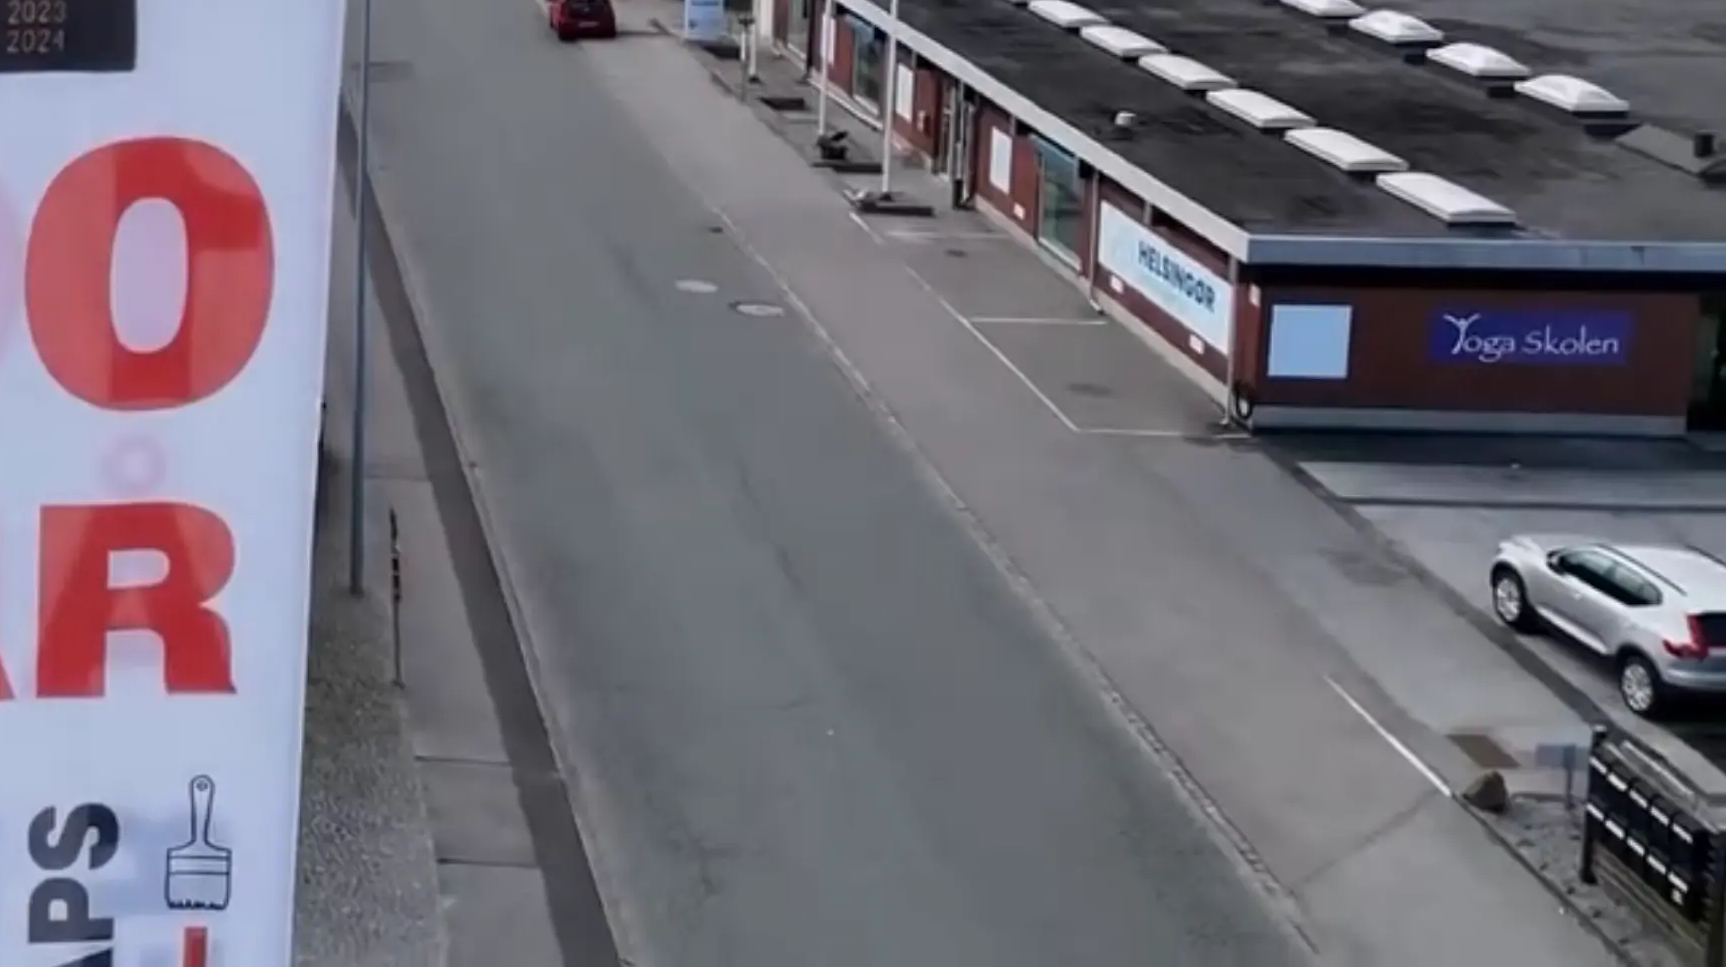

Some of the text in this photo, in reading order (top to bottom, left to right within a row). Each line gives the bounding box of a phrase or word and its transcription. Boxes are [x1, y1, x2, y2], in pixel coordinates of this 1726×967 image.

[5, 28, 66, 54] 2024
[1442, 312, 1620, 364] Yoga Skolen
[27, 802, 120, 967] PS
